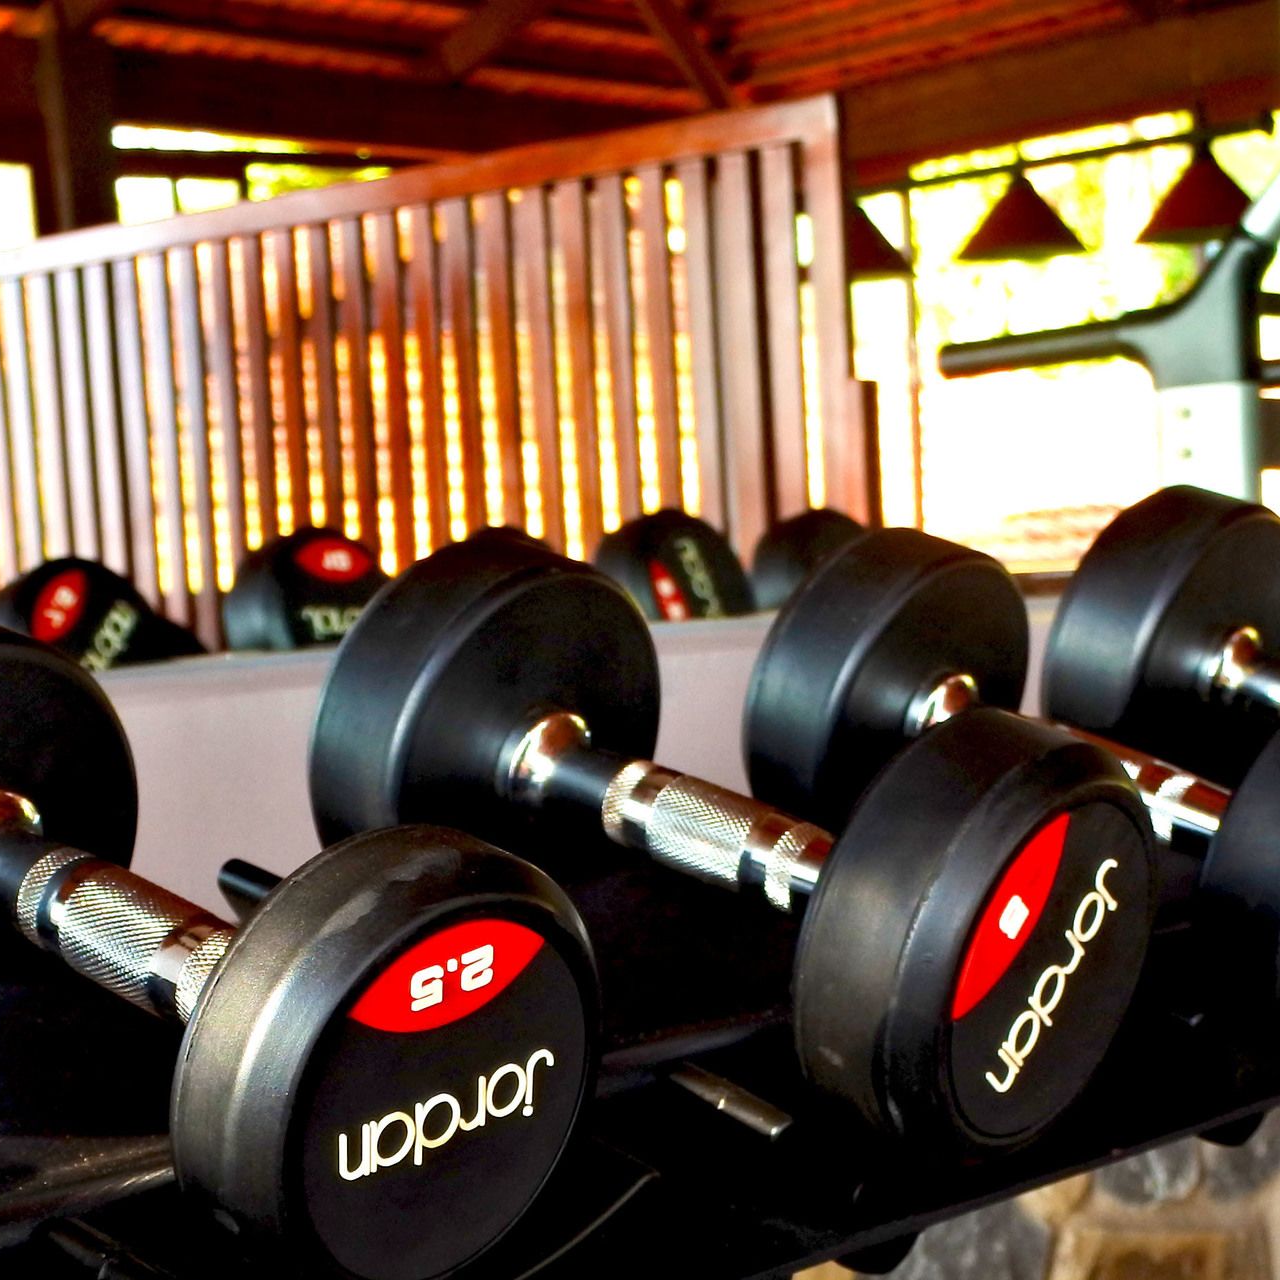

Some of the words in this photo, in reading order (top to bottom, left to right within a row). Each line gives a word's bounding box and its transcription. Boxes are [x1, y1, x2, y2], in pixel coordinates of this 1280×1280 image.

[410, 944, 494, 1012] 2.5
[985, 858, 1118, 1092] jordan
[338, 1048, 554, 1181] jordan
